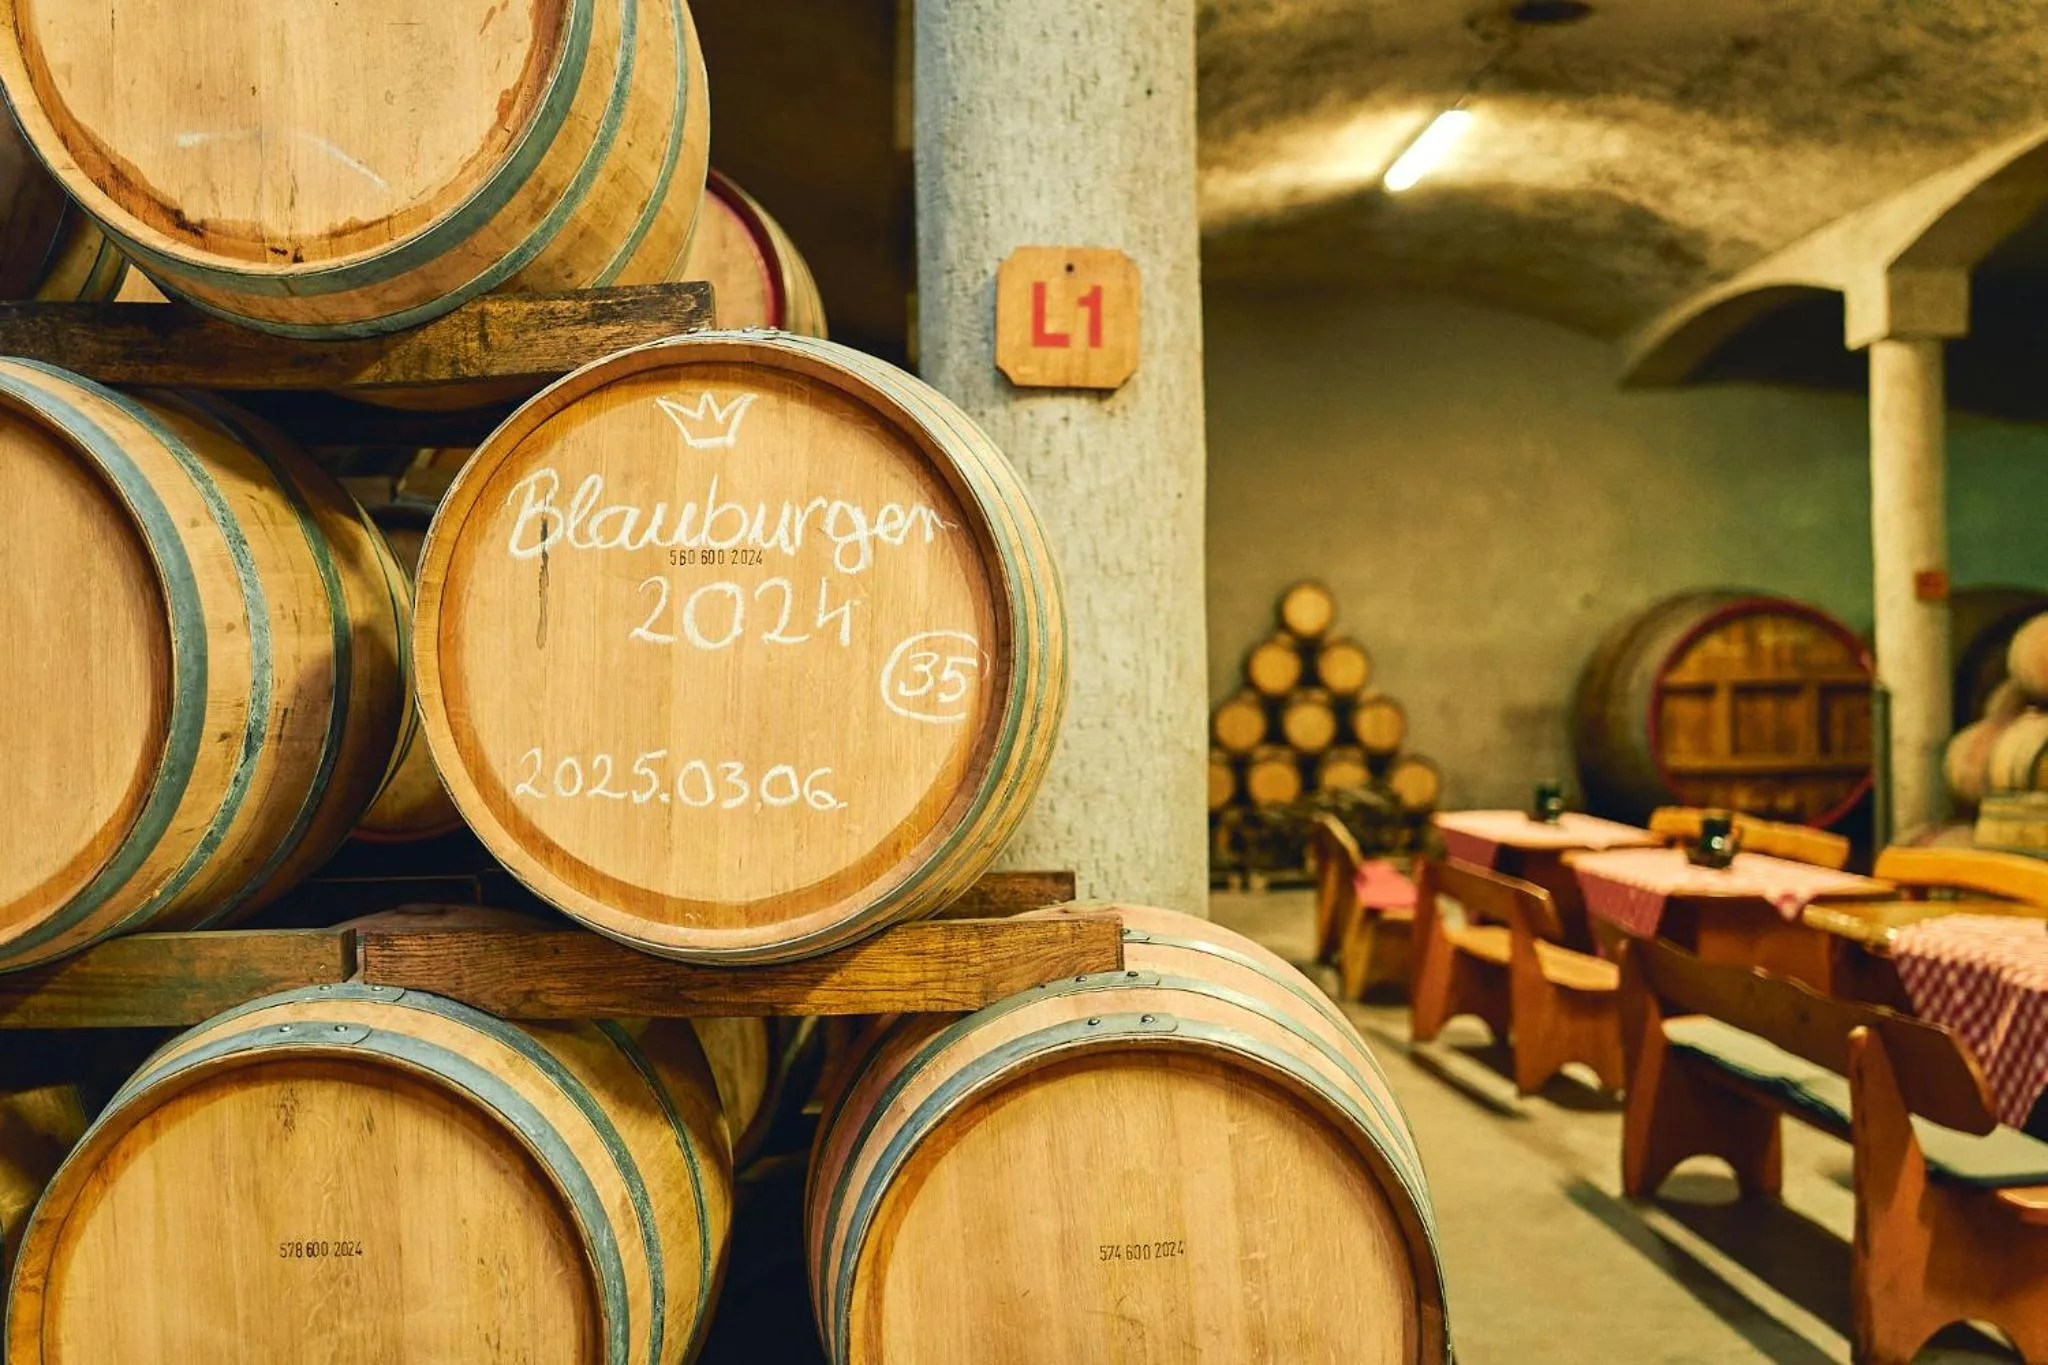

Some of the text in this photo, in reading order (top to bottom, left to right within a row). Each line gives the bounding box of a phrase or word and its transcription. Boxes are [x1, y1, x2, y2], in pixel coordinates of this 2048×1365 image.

[1032, 281, 1104, 349] L1
[507, 467, 958, 574] Blauburger
[669, 549, 763, 566] 560 600 2024
[629, 576, 863, 650] 2024
[898, 651, 979, 703] 35
[280, 1240, 363, 1258] 578 600 2024
[1099, 1240, 1184, 1261] 574 600 2024
